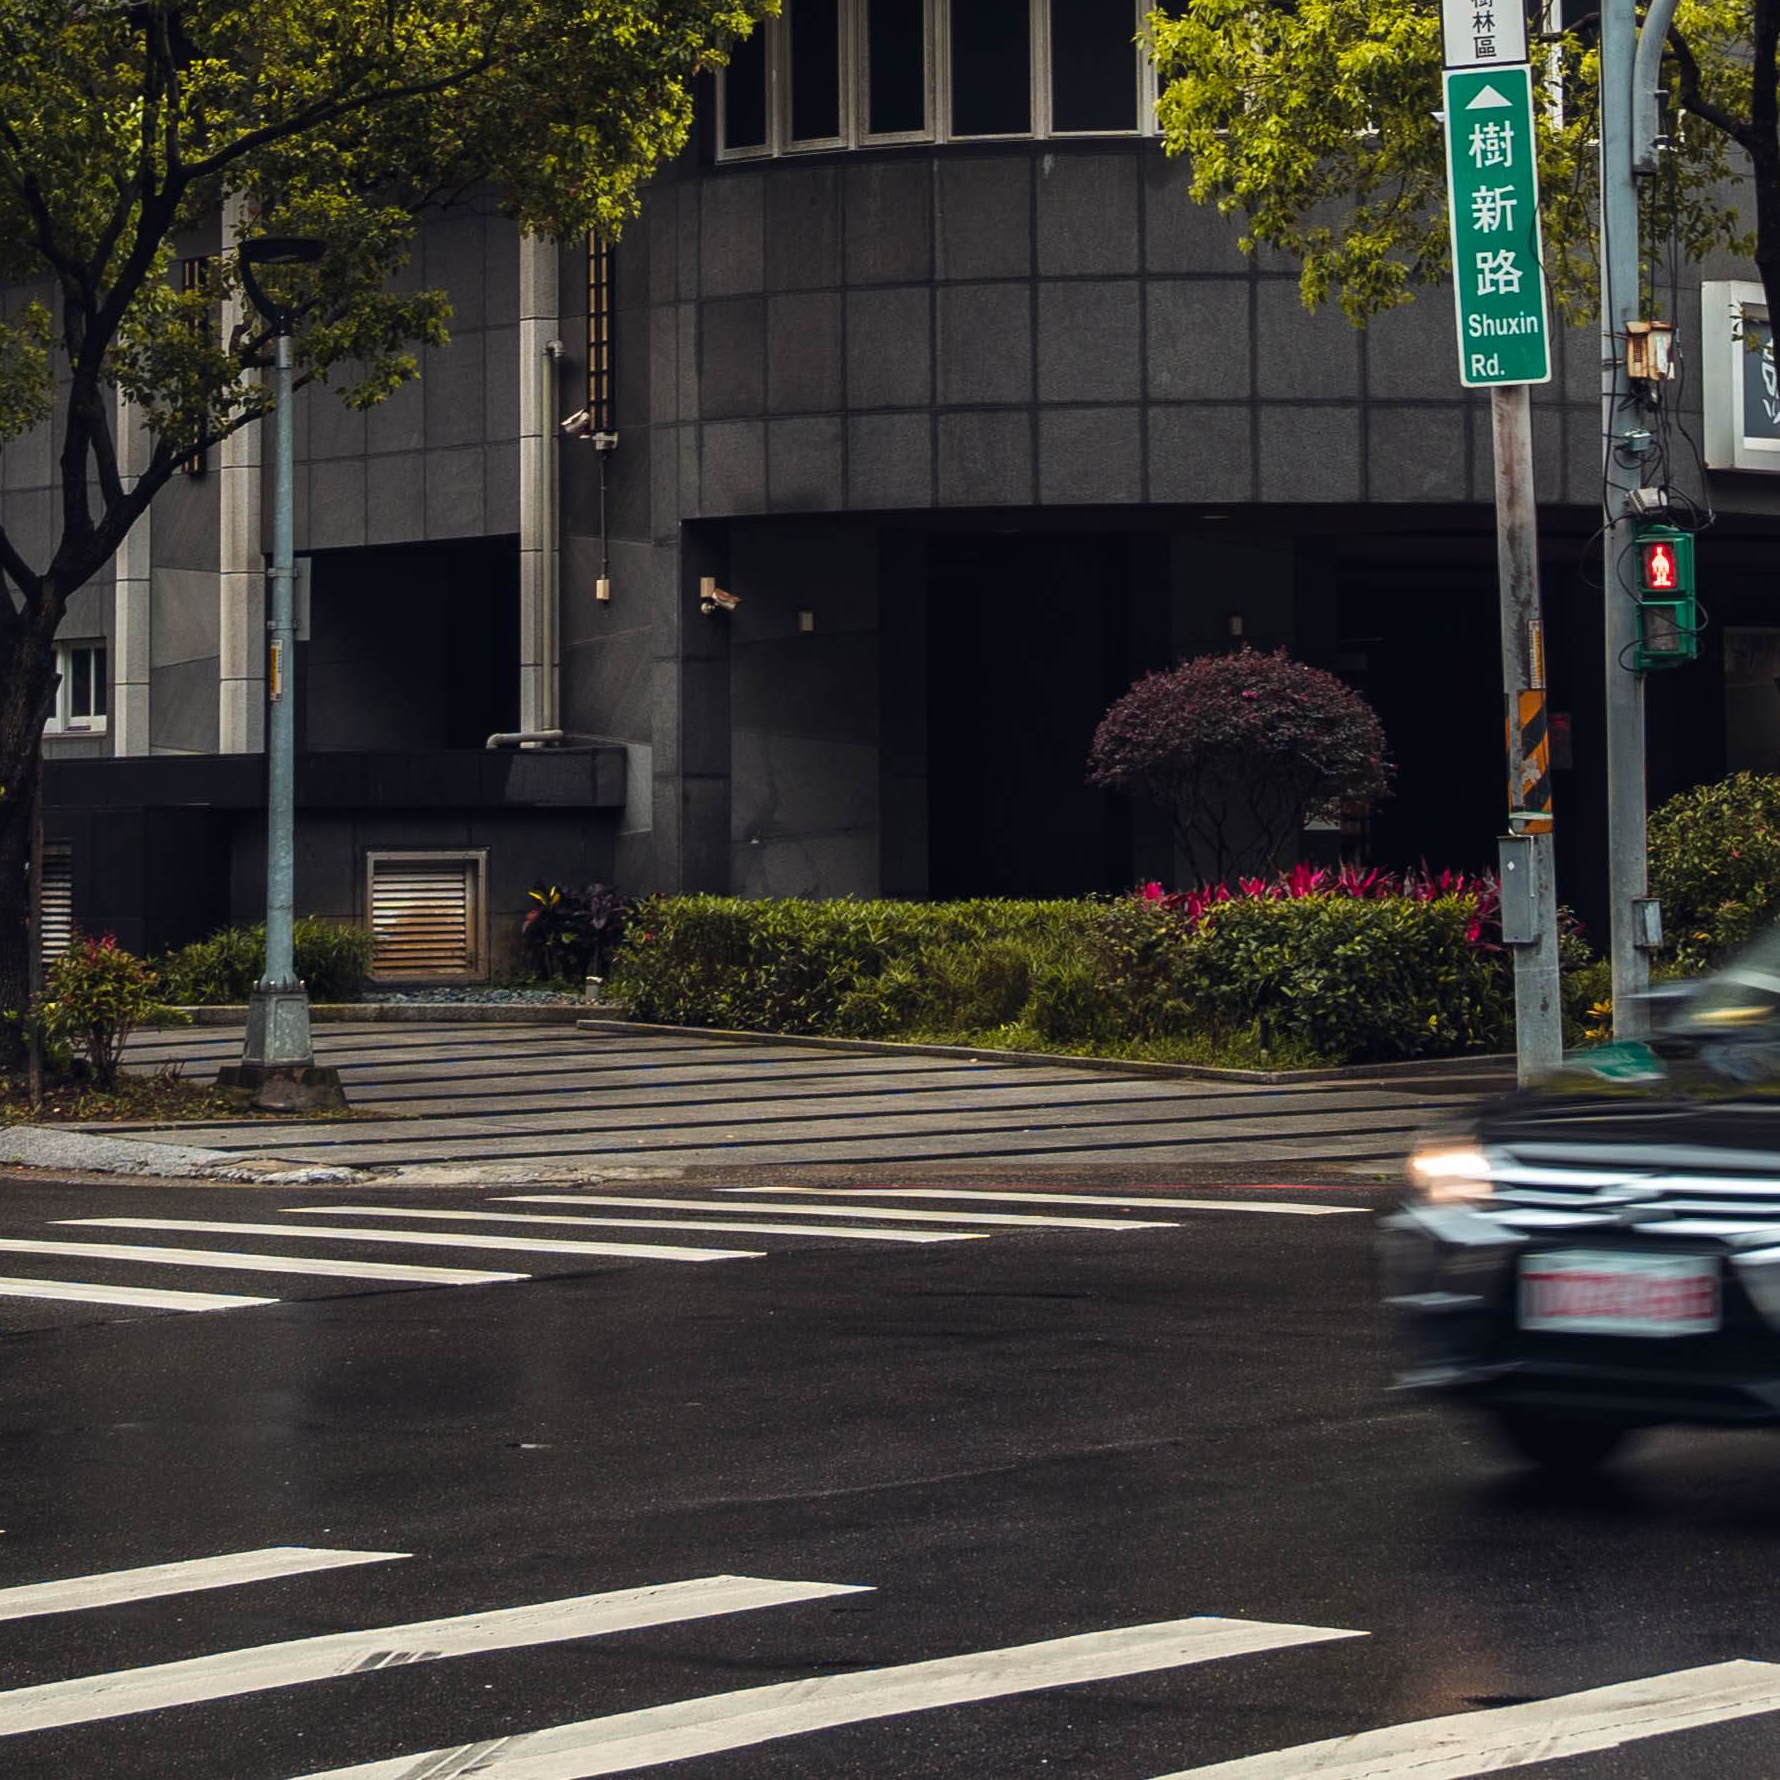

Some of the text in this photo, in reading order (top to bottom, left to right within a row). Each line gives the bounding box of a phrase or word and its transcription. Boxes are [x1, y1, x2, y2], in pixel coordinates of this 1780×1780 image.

[1468, 120, 1523, 297] 樹新路
[1468, 311, 1539, 339] Shuxin
[1470, 353, 1505, 378] Rd.
